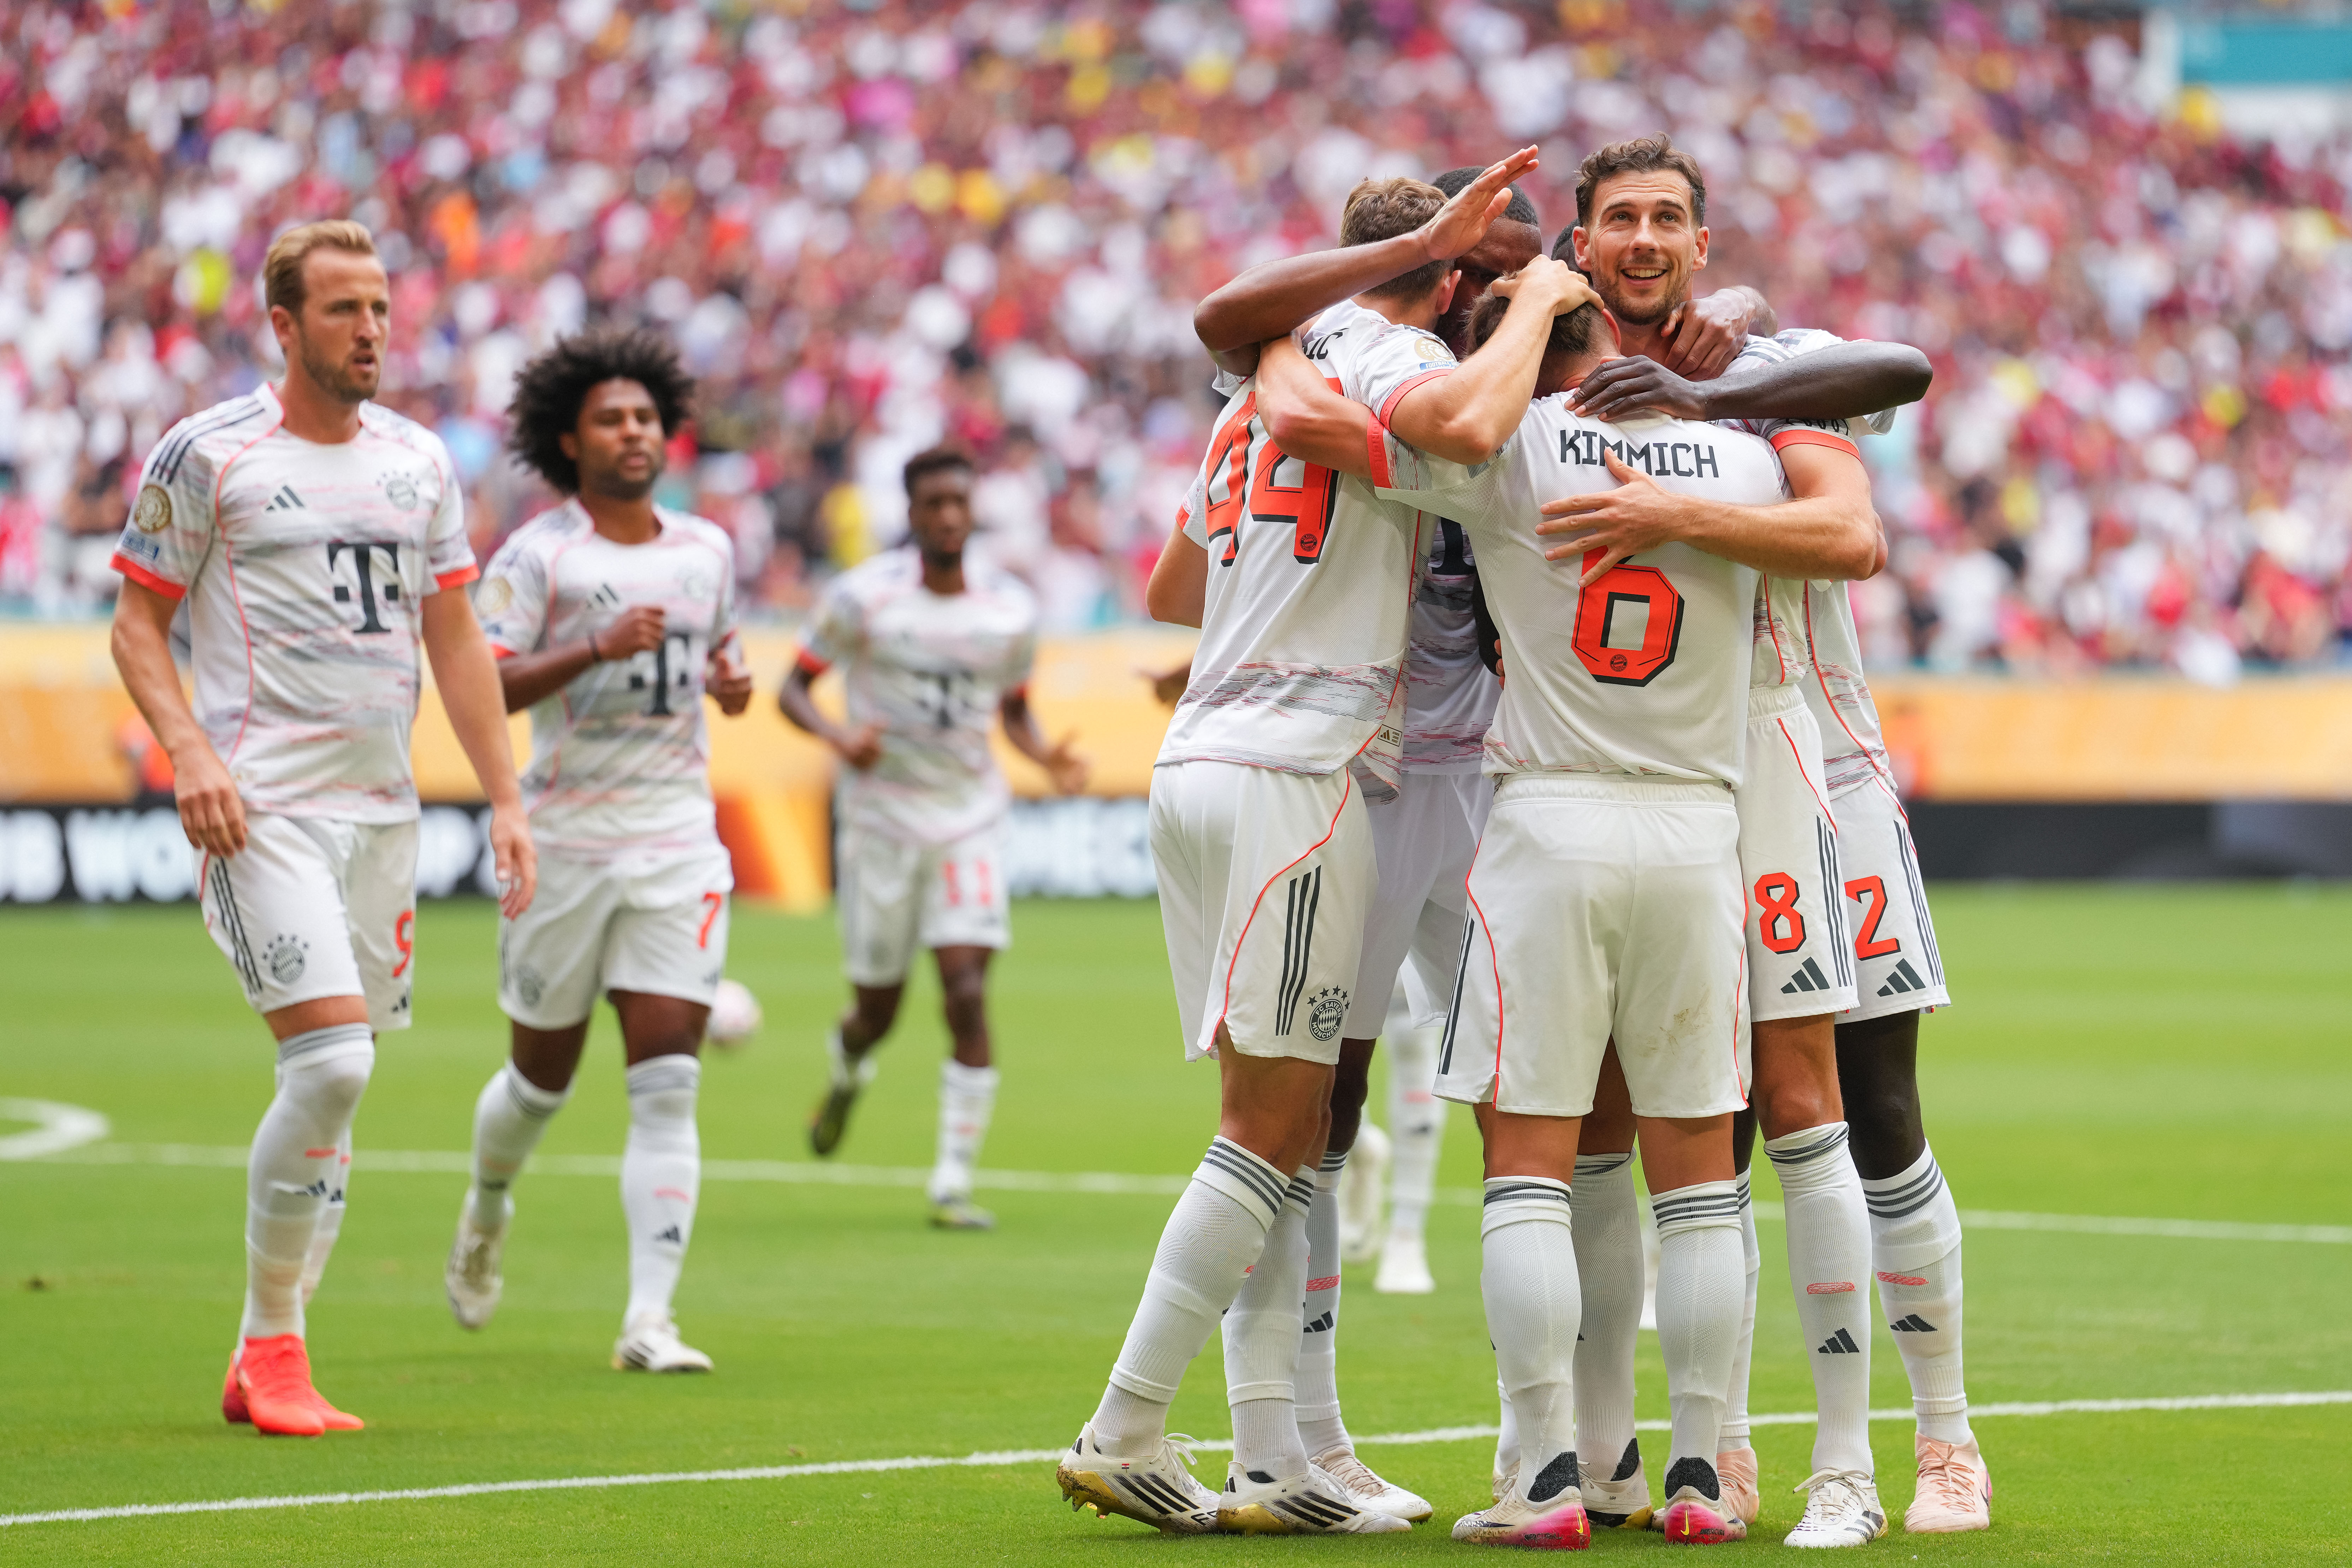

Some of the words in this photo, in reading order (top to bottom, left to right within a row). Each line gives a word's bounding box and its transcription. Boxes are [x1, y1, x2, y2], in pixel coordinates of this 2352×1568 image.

[1560, 430, 1719, 478] KIMMICH
[1571, 545, 1685, 687] 6
[943, 860, 992, 907] 11
[1754, 872, 1806, 955] 8
[392, 910, 414, 978] 9
[698, 892, 723, 950] 7
[1844, 875, 1901, 961] 2
[1315, 1006, 1324, 1015] FC
[1326, 1002, 1341, 1018] BAYERN
